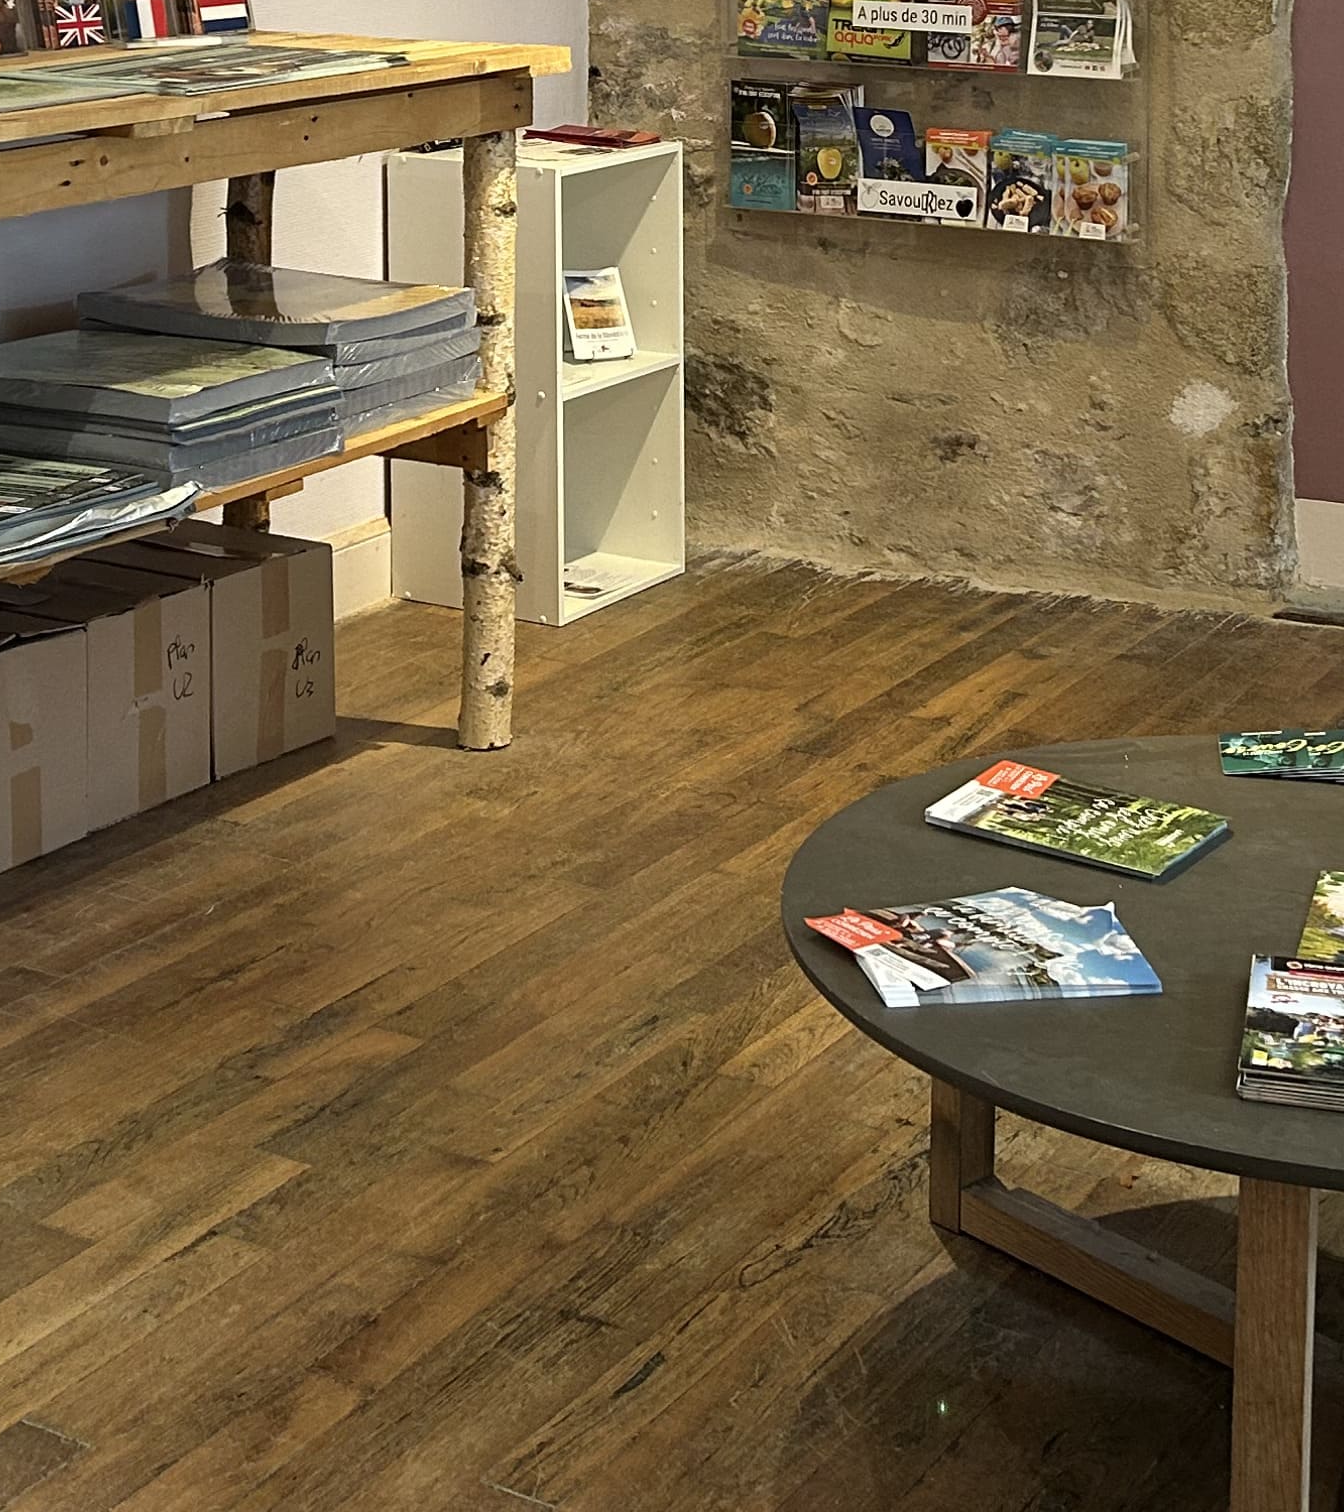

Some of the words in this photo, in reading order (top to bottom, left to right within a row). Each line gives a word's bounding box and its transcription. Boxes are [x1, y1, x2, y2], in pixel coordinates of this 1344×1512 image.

[858, 6, 866, 20] A
[870, 6, 898, 23] plus
[901, 8, 918, 22] de
[922, 10, 938, 24] 30
[942, 12, 966, 26] min
